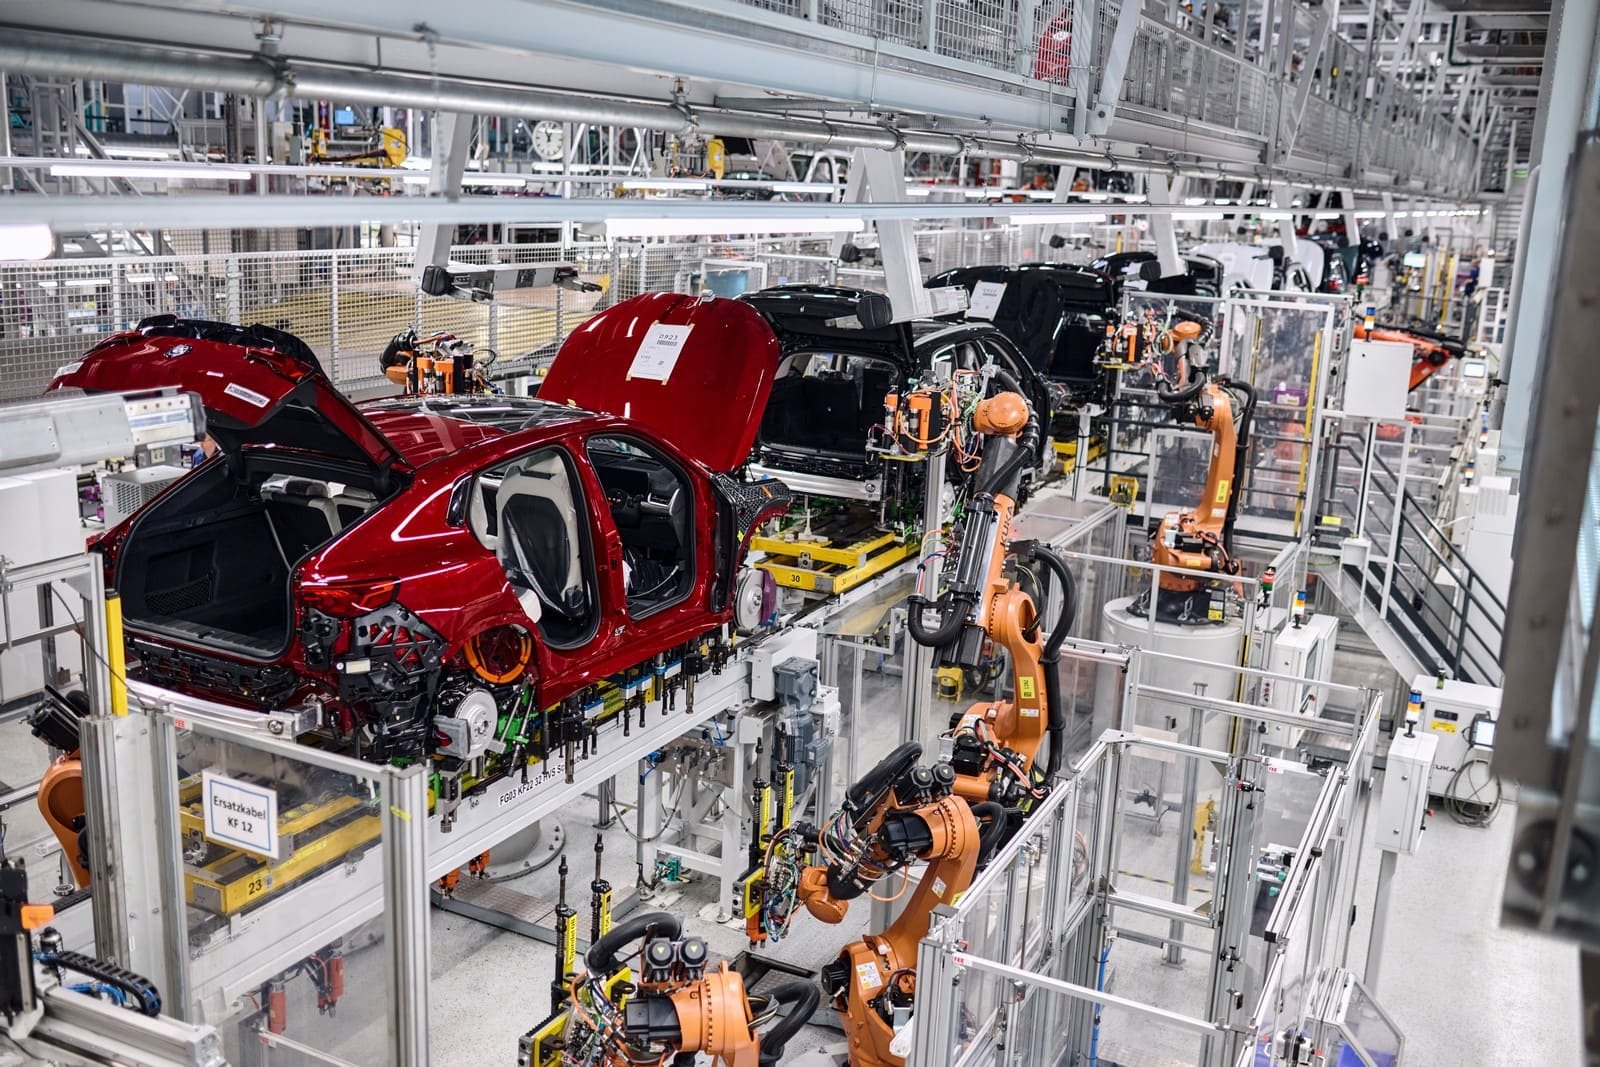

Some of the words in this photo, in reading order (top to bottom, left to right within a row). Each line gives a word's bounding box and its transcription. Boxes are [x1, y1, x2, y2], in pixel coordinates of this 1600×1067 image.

[1000, 506, 1013, 547] KUKA
[791, 574, 801, 582] 30
[499, 789, 517, 806] FG03
[517, 780, 534, 797] KF22
[534, 775, 543, 787] 32
[213, 795, 266, 820] Ersatzkabel
[227, 816, 239, 829] KF
[241, 821, 254, 833] 12
[248, 879, 263, 896] 23
